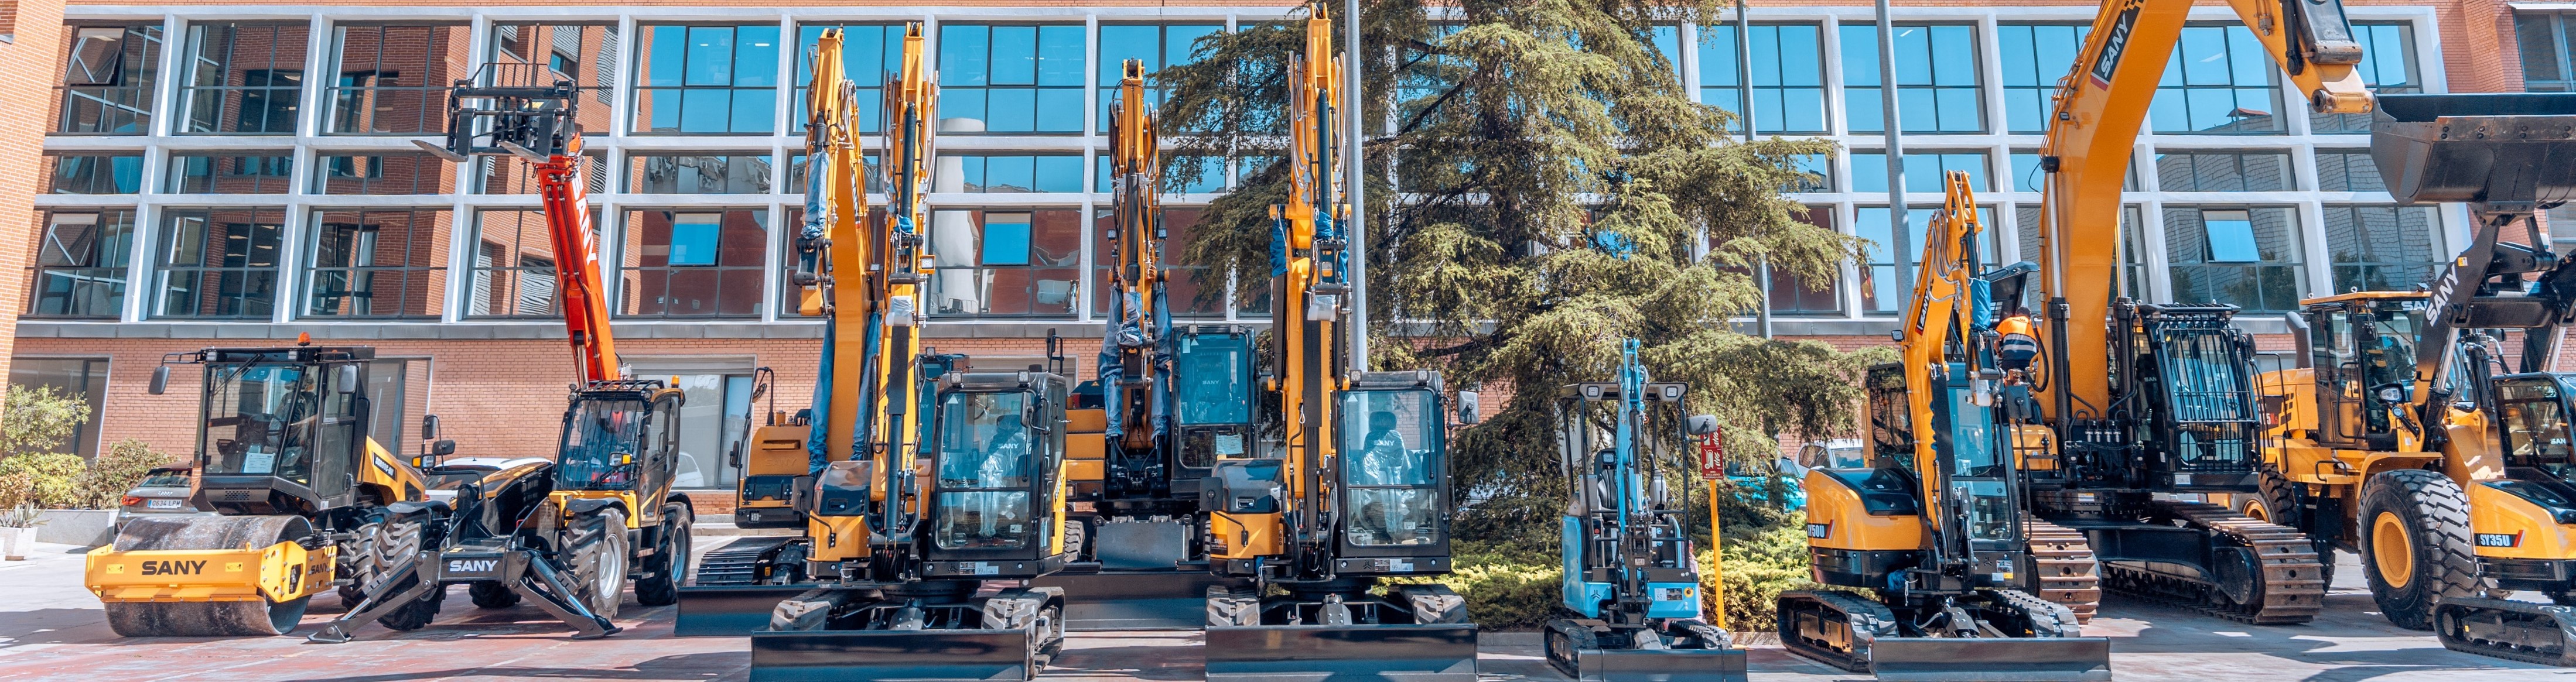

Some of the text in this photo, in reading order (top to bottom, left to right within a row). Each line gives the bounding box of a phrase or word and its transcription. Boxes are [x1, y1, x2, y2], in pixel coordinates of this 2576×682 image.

[2101, 12, 2128, 78] SANY
[572, 169, 597, 266] SANY
[2426, 263, 2459, 327] SANY
[2401, 301, 2428, 311] SA
[2480, 534, 2510, 546] SY35U
[142, 560, 207, 575] SANY
[310, 563, 329, 574] SANY
[449, 560, 498, 571] SANY
